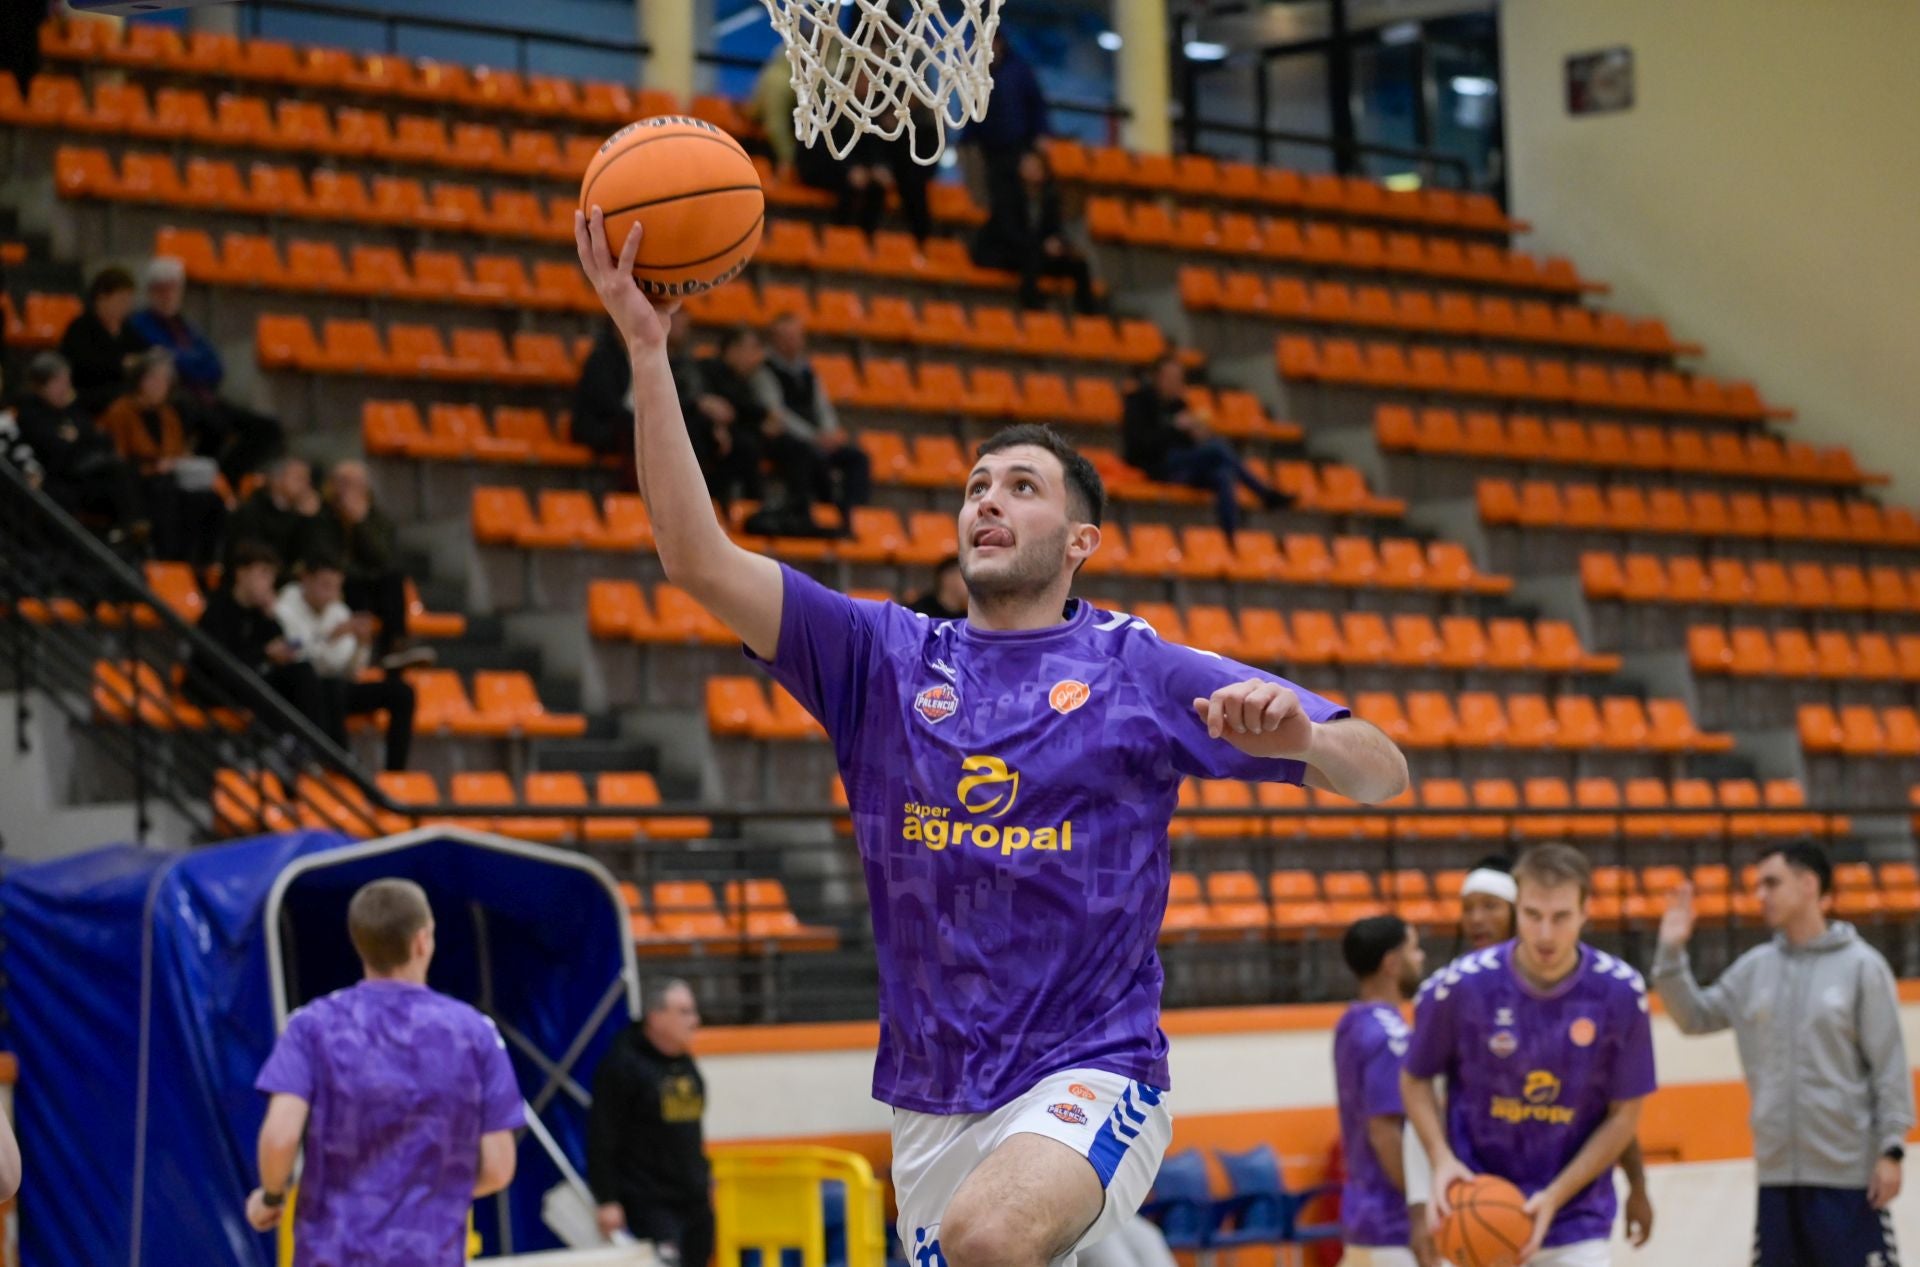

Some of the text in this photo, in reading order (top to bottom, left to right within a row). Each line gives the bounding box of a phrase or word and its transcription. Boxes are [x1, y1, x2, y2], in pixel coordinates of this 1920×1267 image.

[917, 695, 956, 711] PALENCIA
[903, 801, 950, 818] súper
[902, 816, 1072, 855] agropal
